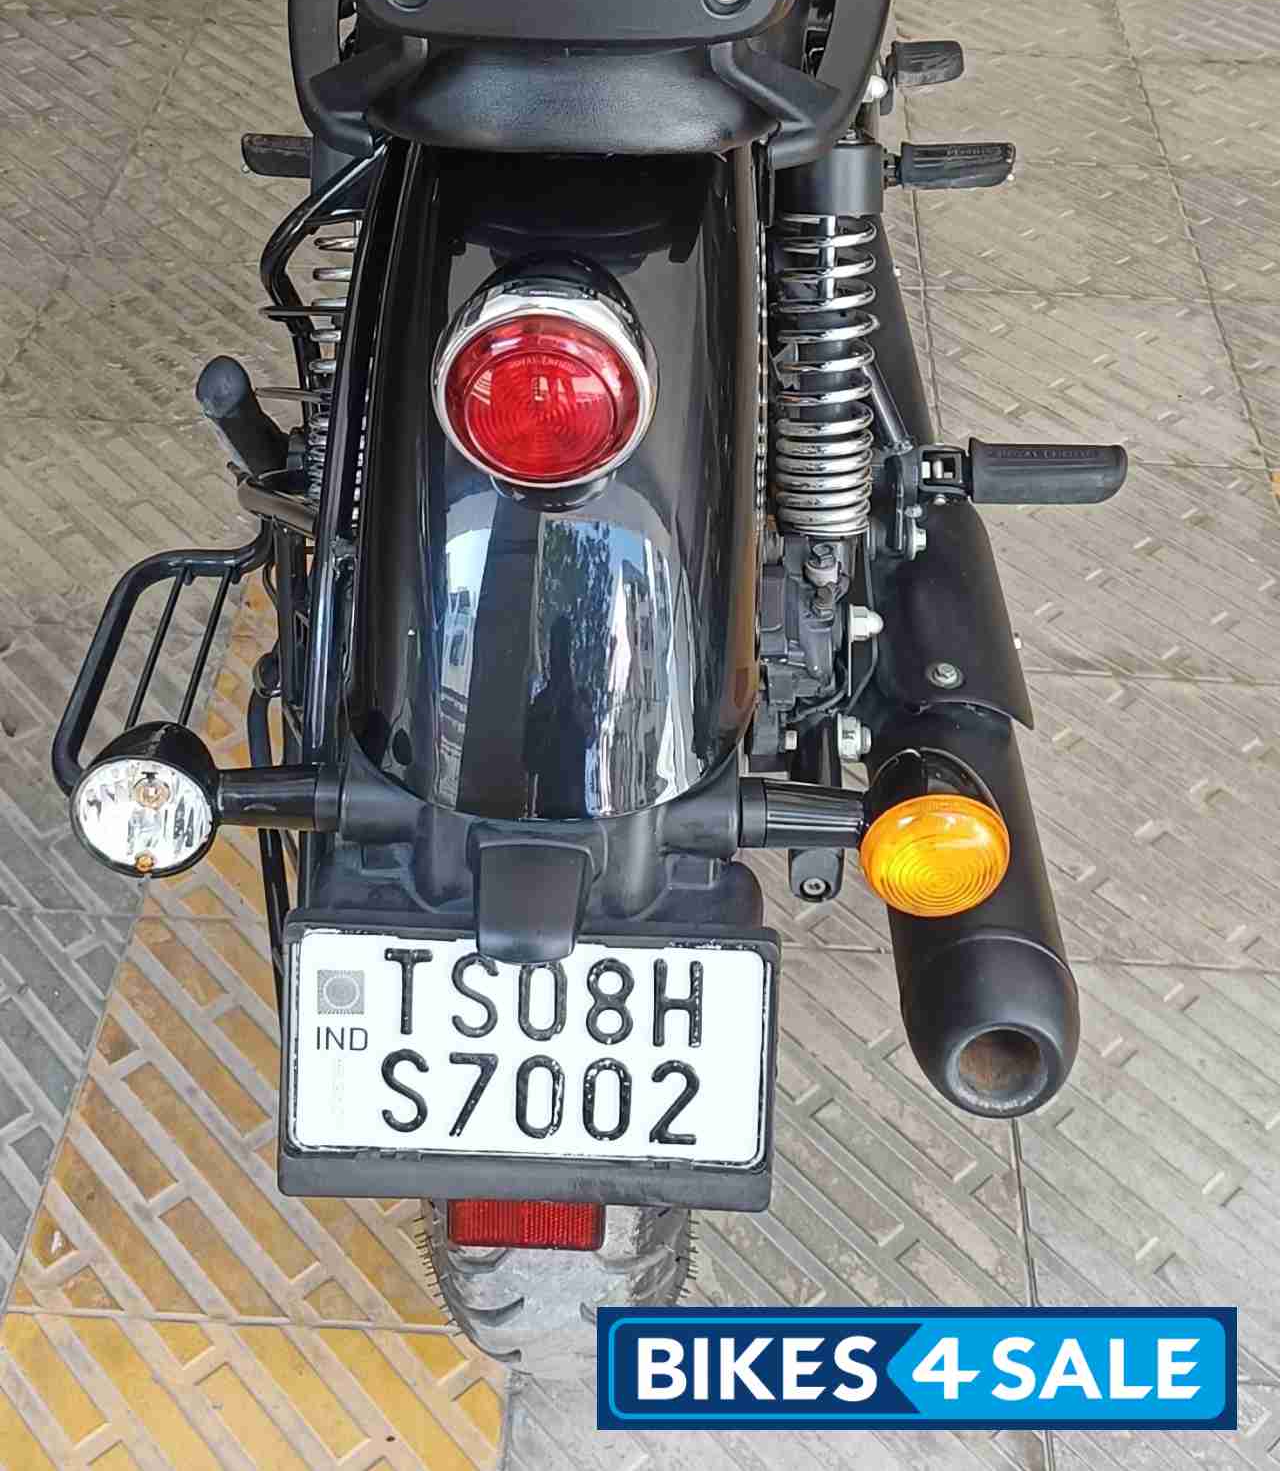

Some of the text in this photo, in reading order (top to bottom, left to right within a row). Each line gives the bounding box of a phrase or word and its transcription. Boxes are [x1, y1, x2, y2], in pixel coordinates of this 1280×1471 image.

[316, 1026, 369, 1051] IND
[384, 947, 704, 1048] TS08H
[381, 1048, 700, 1146] S7002
